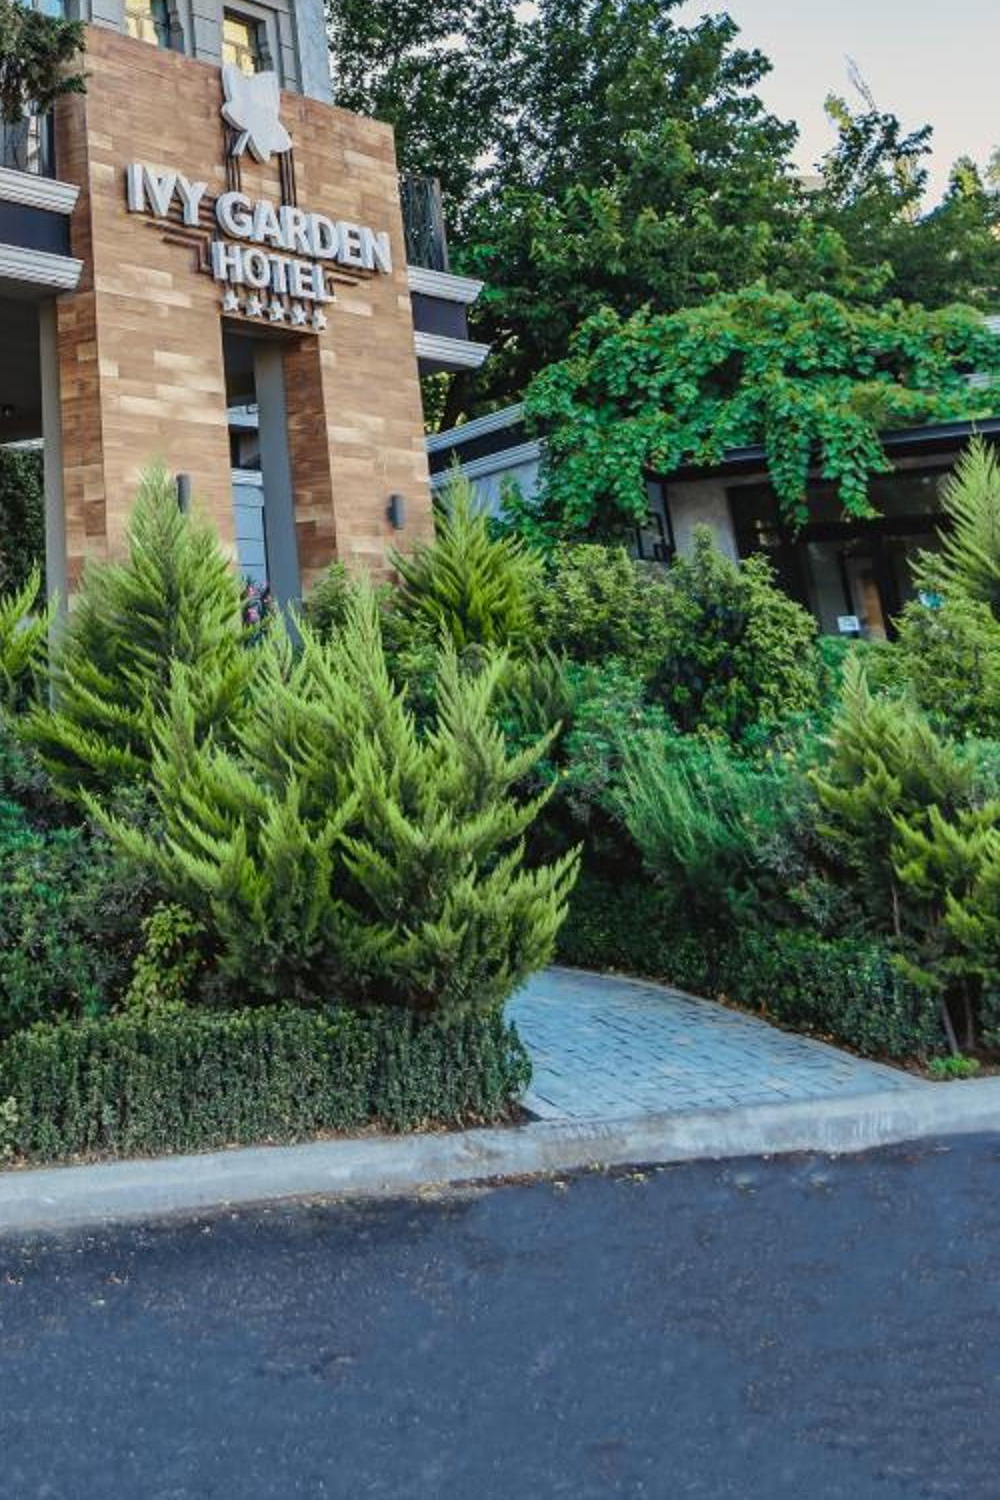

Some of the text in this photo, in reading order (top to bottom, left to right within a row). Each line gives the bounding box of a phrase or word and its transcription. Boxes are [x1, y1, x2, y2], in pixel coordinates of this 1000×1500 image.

[126, 163, 392, 274] IVY GARDEN
[212, 241, 336, 303] HOTEL
